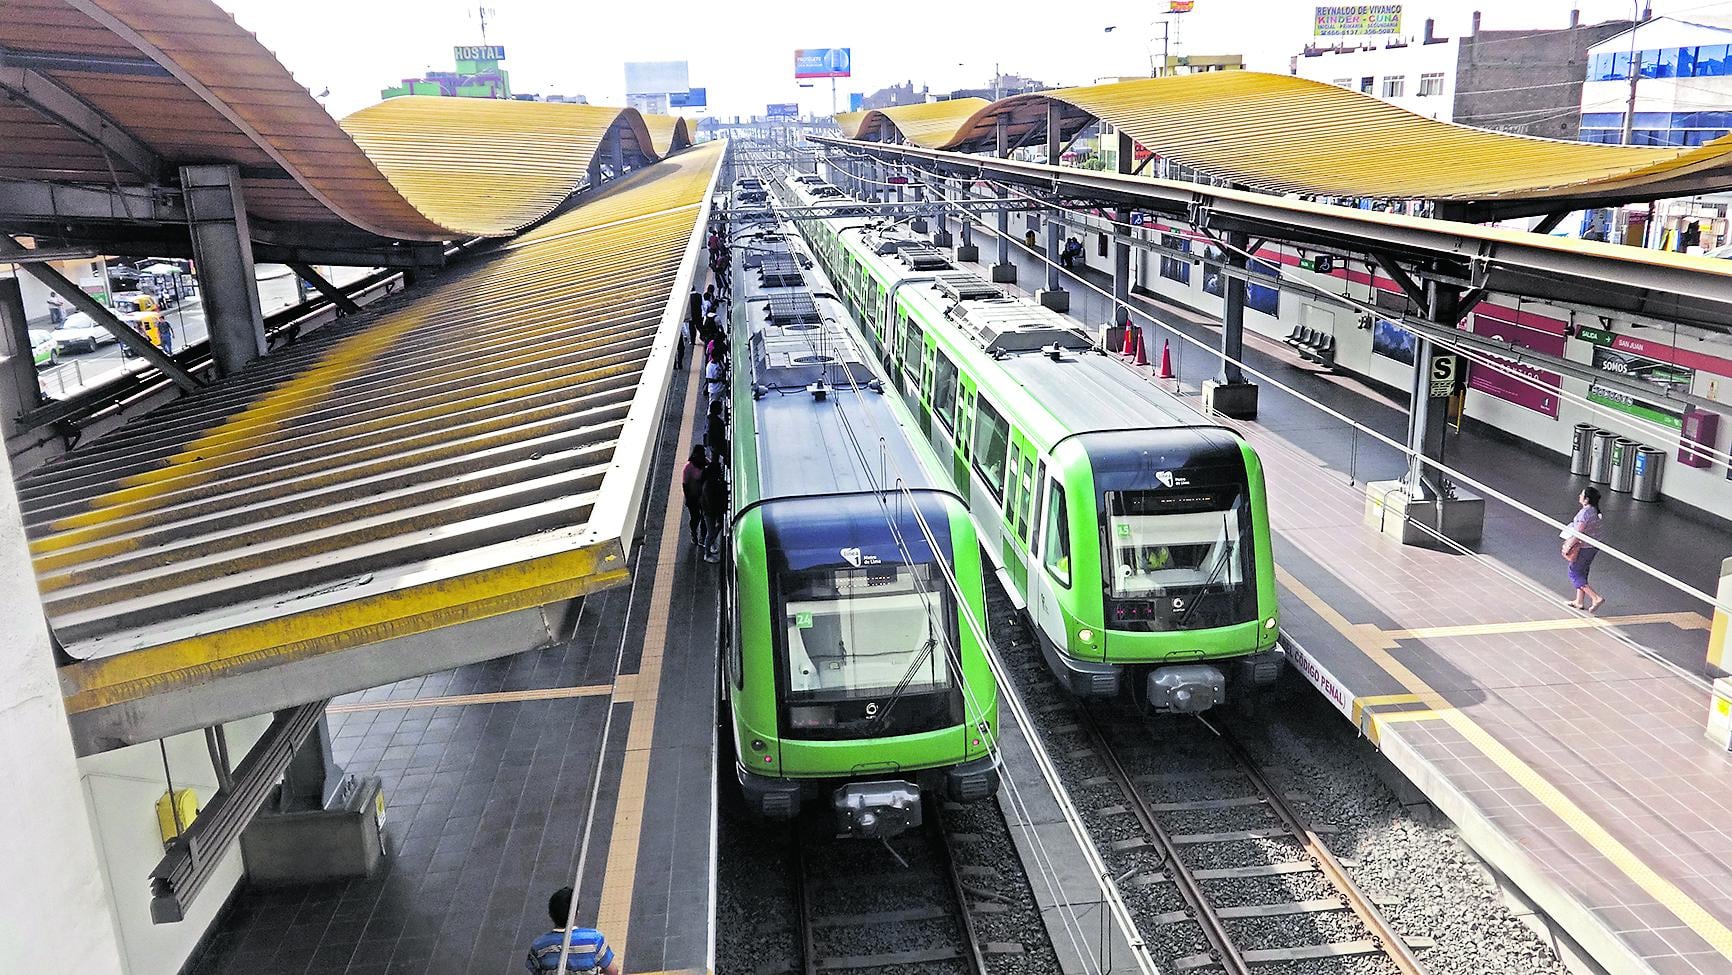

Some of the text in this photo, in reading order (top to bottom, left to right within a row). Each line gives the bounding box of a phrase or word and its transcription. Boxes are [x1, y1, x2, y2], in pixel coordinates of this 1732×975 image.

[1317, 5, 1401, 16] REYNALDO DE VIVANCO
[1318, 15, 1360, 24] KINDER
[1368, 14, 1399, 22] CUNA
[454, 46, 504, 60] HOSTAL
[1618, 339, 1644, 351] SAN JUAN
[1433, 357, 1452, 380] S
[1602, 360, 1628, 374] SOMOS
[854, 556, 860, 565] 1
[797, 614, 811, 625] 24
